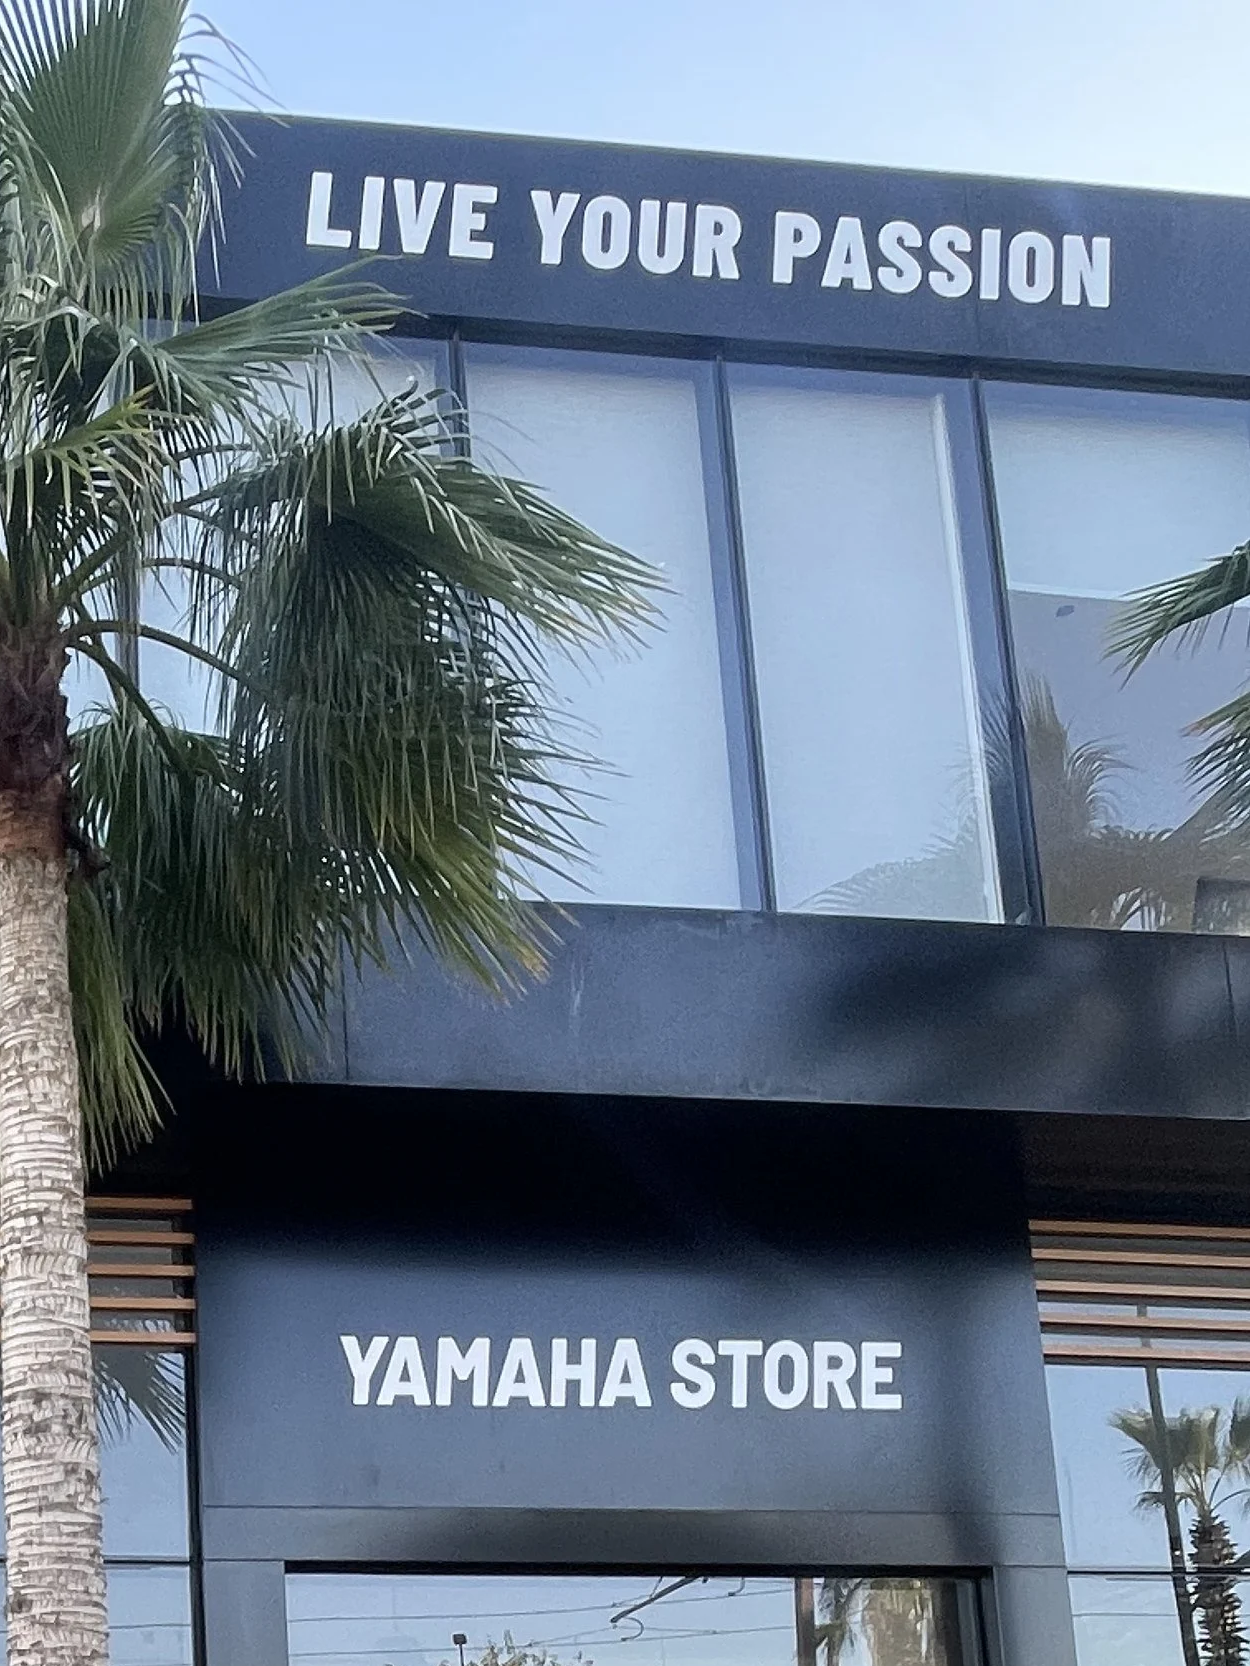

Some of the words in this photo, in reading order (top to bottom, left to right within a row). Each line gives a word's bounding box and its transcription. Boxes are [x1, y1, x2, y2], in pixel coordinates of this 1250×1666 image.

[306, 171, 499, 260] LIVE
[529, 189, 743, 281] YOUR
[772, 210, 1112, 309] PASSION
[339, 1335, 652, 1408] YAMAHA
[669, 1337, 903, 1411] STORE
